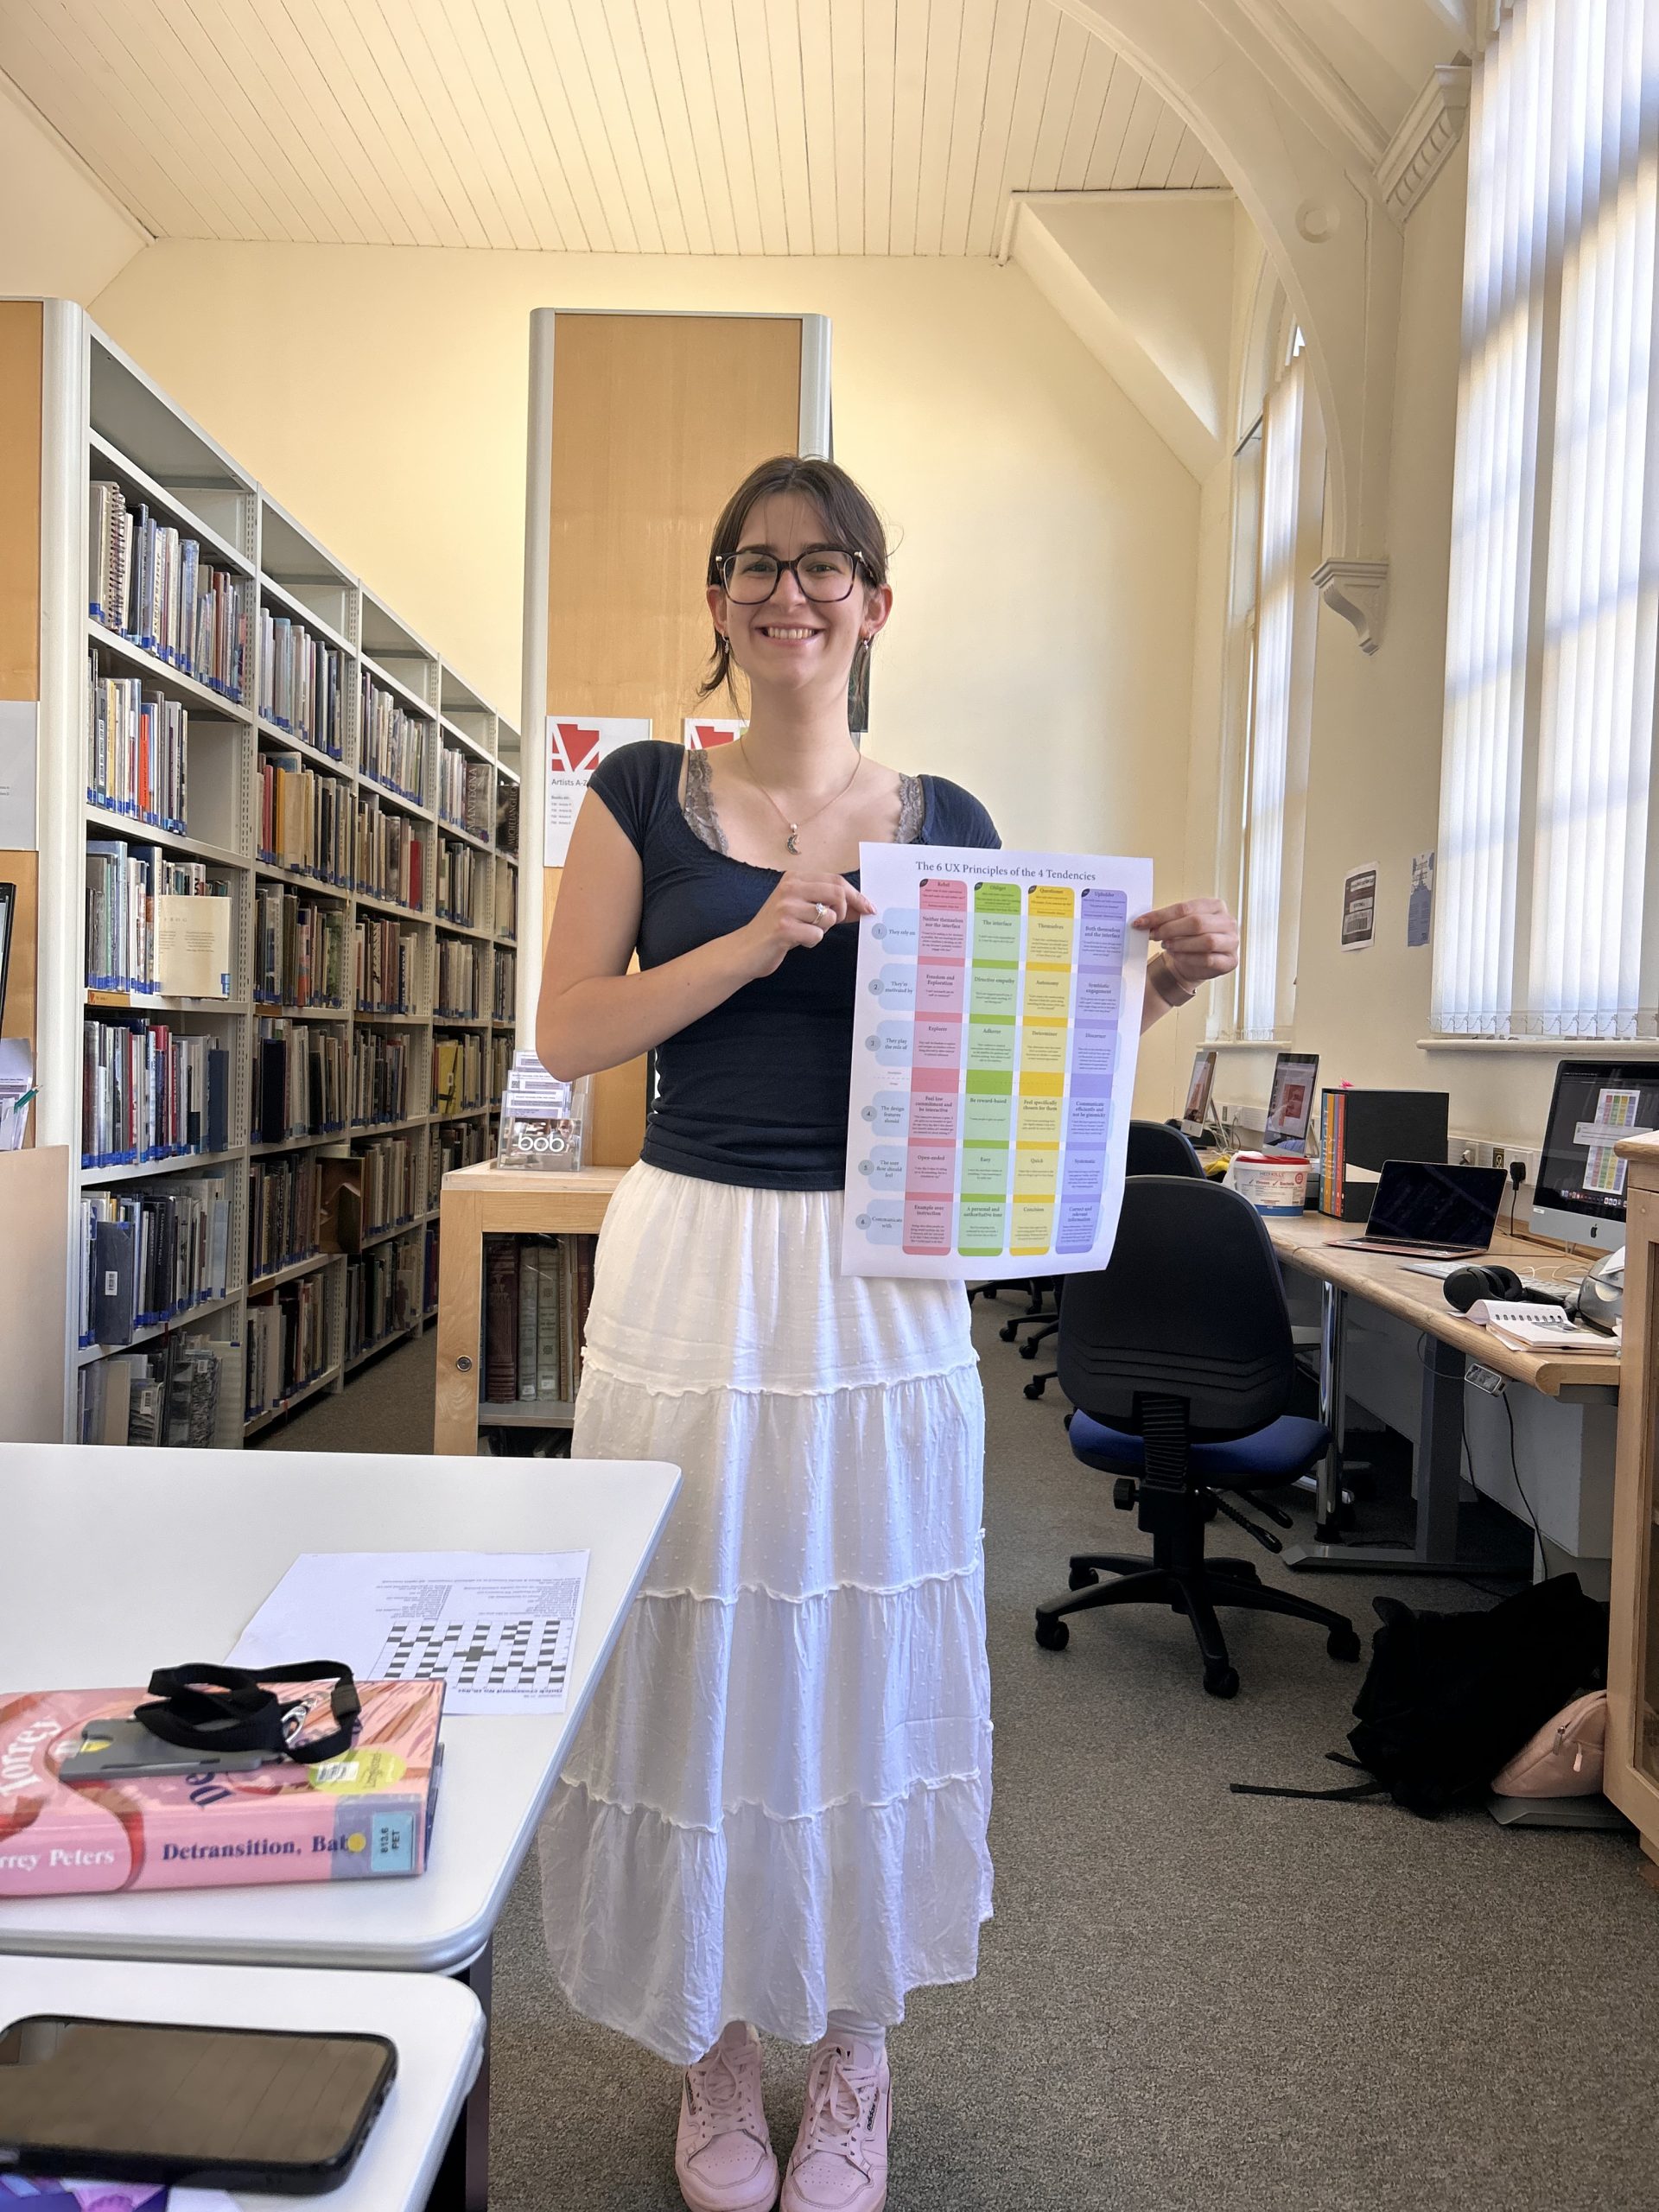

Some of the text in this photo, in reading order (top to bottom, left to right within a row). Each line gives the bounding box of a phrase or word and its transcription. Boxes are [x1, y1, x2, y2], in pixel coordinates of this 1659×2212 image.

[467, 766, 478, 830] MANTEGNA
[508, 786, 517, 846] MICHELANGELO
[916, 861, 934, 871] The
[945, 864, 961, 873] UX
[963, 865, 1007, 876] Principles
[1010, 868, 1020, 876] of
[1022, 868, 1036, 877] the
[1047, 870, 1096, 880] Tendencies
[518, 1132, 565, 1153] bob
[1327, 1134, 1336, 1179] RILEY
[49, 1847, 115, 1867] Peters
[162, 1836, 302, 1862] Detransition,
[311, 1833, 349, 1854] Bab
[380, 1826, 390, 1854] 813.6
[391, 1829, 401, 1850] PET
[866, 2102, 876, 2132] adidas
